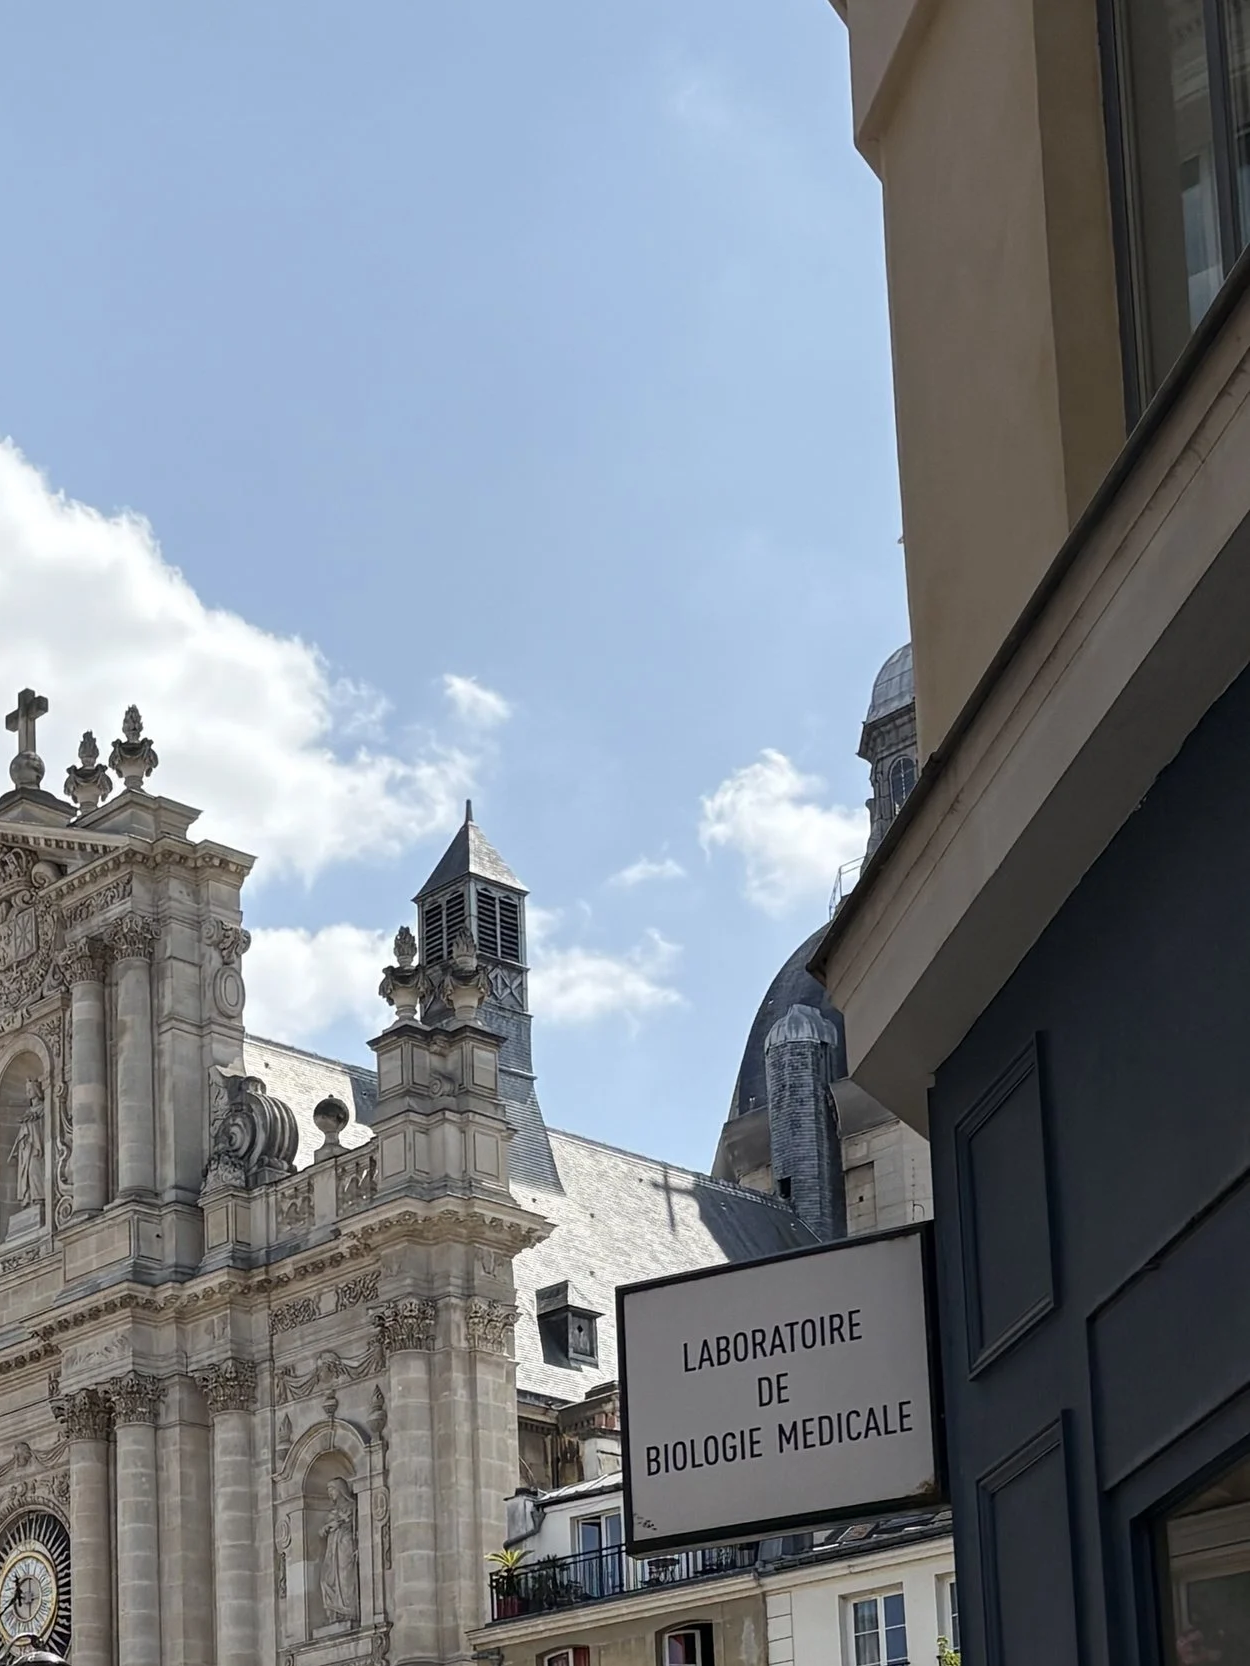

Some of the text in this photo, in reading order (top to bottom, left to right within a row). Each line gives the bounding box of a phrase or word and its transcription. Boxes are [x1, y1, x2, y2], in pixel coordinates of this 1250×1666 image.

[683, 1309, 863, 1373] LABORATOIRE
[757, 1372, 790, 1408] DE
[646, 1401, 913, 1477] BIOLOGIE MEDICALE
